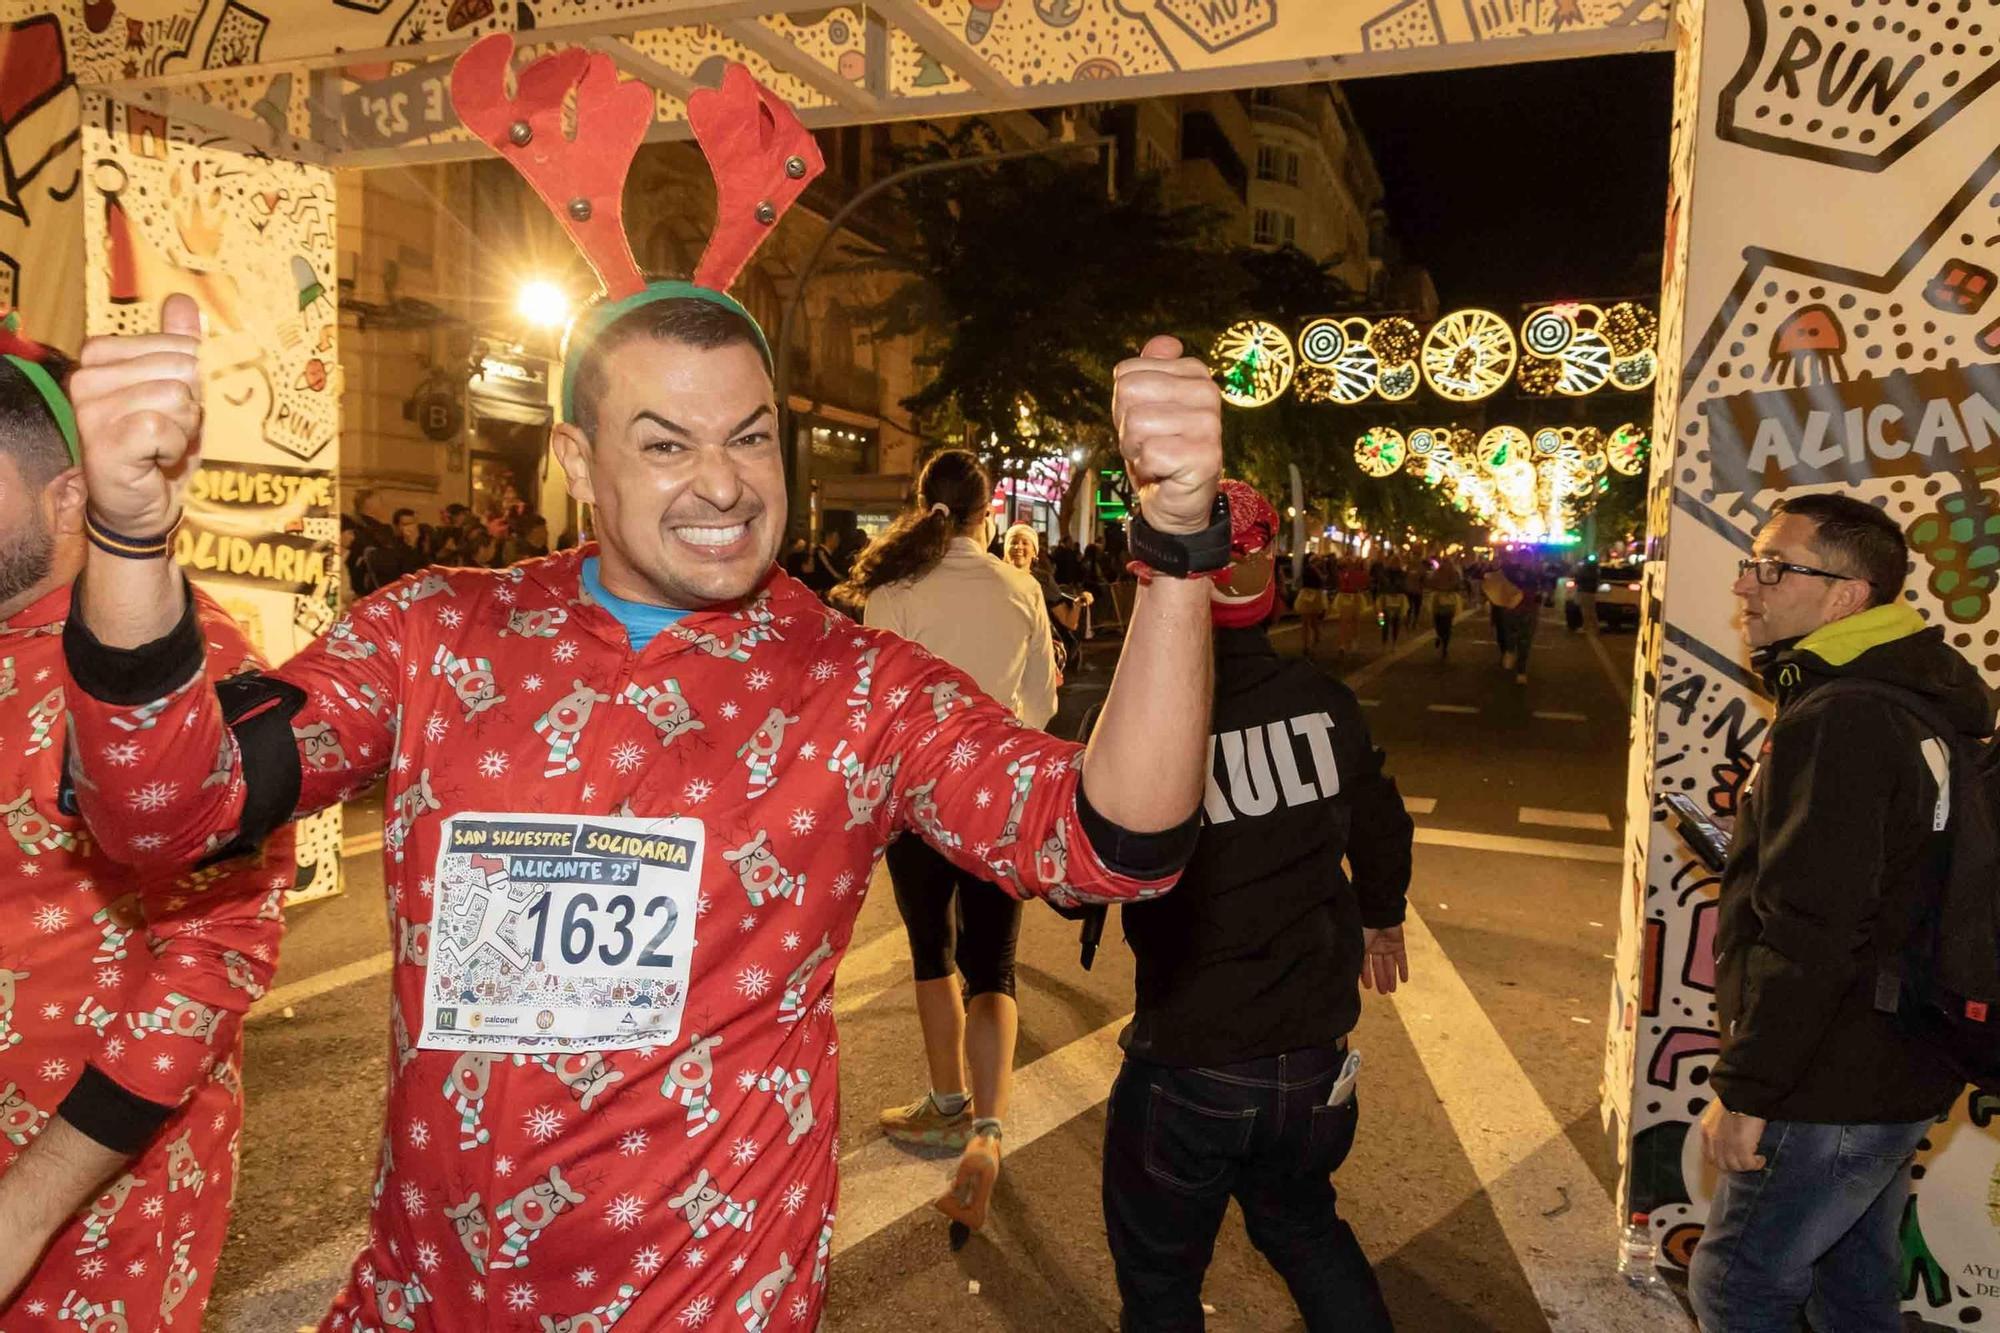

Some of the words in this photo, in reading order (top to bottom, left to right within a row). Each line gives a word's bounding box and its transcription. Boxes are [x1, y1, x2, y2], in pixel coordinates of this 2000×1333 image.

[1764, 26, 1925, 116] RUN
[278, 403, 318, 441] RUN
[429, 405, 448, 428] B
[1747, 392, 2000, 474] ALICAN
[190, 468, 333, 507] SILVESTRE
[174, 528, 326, 585] OLIDARIA
[455, 829, 487, 847] SAN
[492, 829, 572, 848] SILVESTRE
[586, 831, 688, 865] SOLIDARIA
[511, 859, 603, 880] ALICANTE
[611, 860, 638, 882] 25'
[528, 891, 679, 968] 1632
[484, 1015, 518, 1025] calconut
[1962, 1263, 2000, 1280] AYU
[1976, 1283, 2000, 1298] DE
